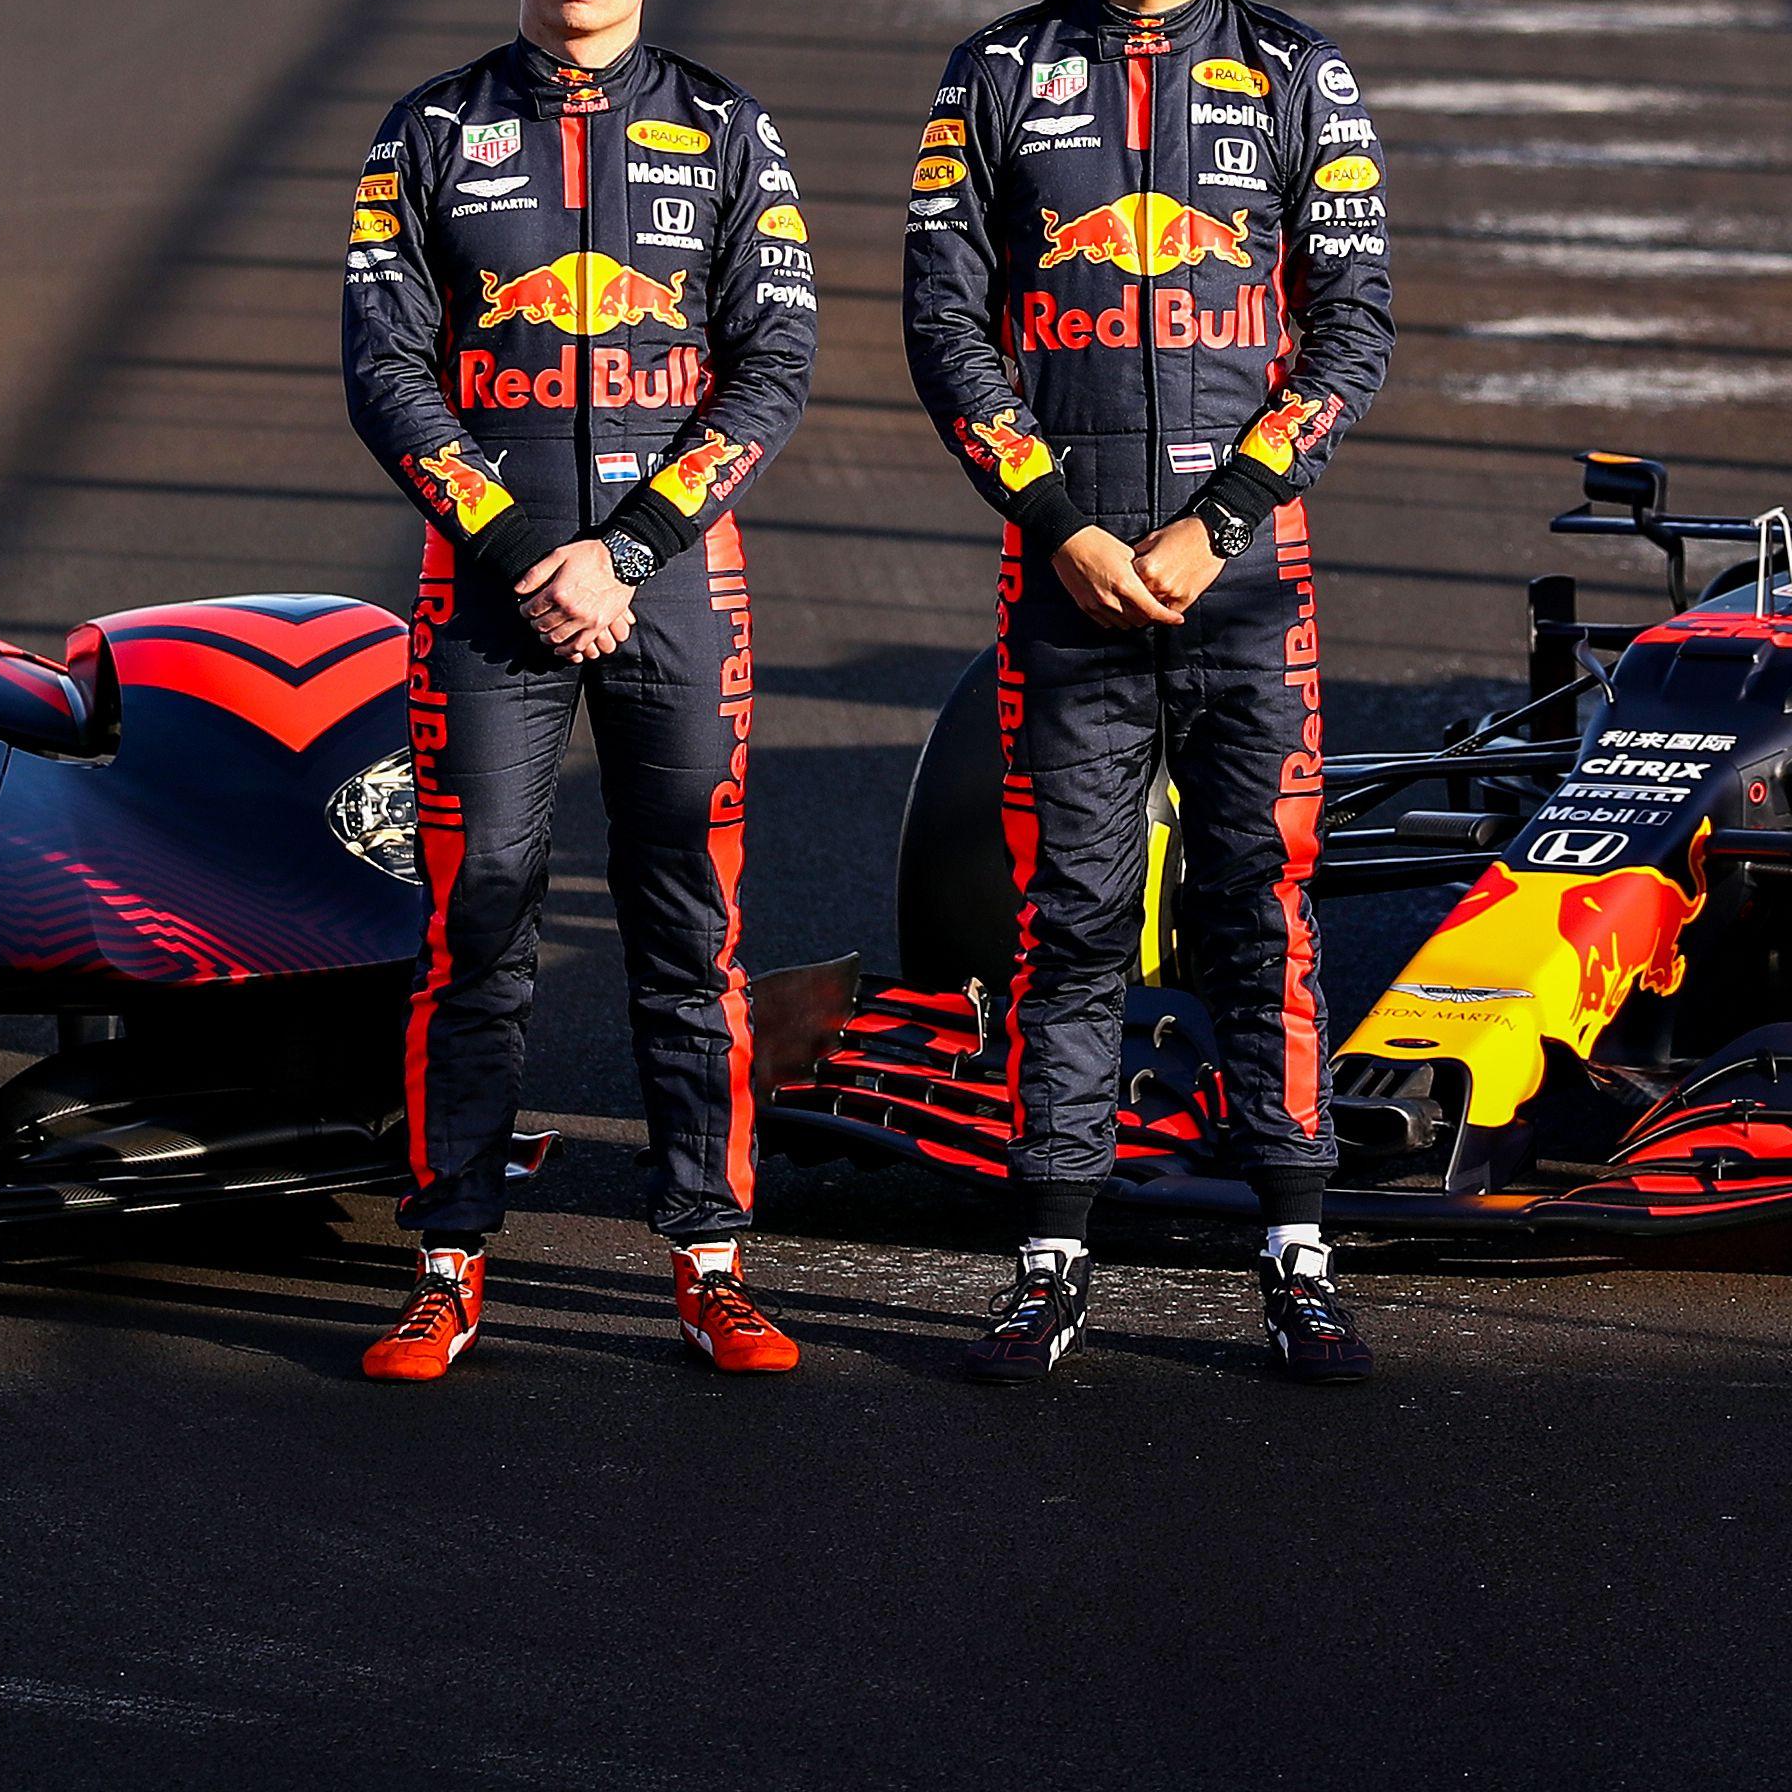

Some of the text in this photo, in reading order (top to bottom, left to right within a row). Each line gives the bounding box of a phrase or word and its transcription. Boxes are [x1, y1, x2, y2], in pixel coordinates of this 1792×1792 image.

[1036, 60, 1085, 84] TAG
[1035, 77, 1085, 103] HEUER
[1191, 103, 1255, 127] Mobil
[466, 122, 517, 144] TAG
[650, 129, 701, 147] RAUCH
[1054, 136, 1101, 151] MARTIN
[467, 139, 519, 162] HEUER
[628, 162, 692, 187] Mobil
[919, 165, 955, 181] RAUCH
[1198, 172, 1268, 192] HONDA
[451, 197, 539, 218] ASTON MARTIN
[1310, 195, 1387, 223] DITA
[353, 219, 393, 234] AUCH
[636, 233, 705, 251] HONDA
[1022, 284, 1268, 352] Red Bull
[459, 344, 700, 409] Red Bull
[1597, 729, 1738, 752] 利来国际
[1558, 782, 1691, 803] PIRELLI
[1538, 805, 1636, 823] Mobil
[1432, 1010, 1518, 1032] MARTIN
